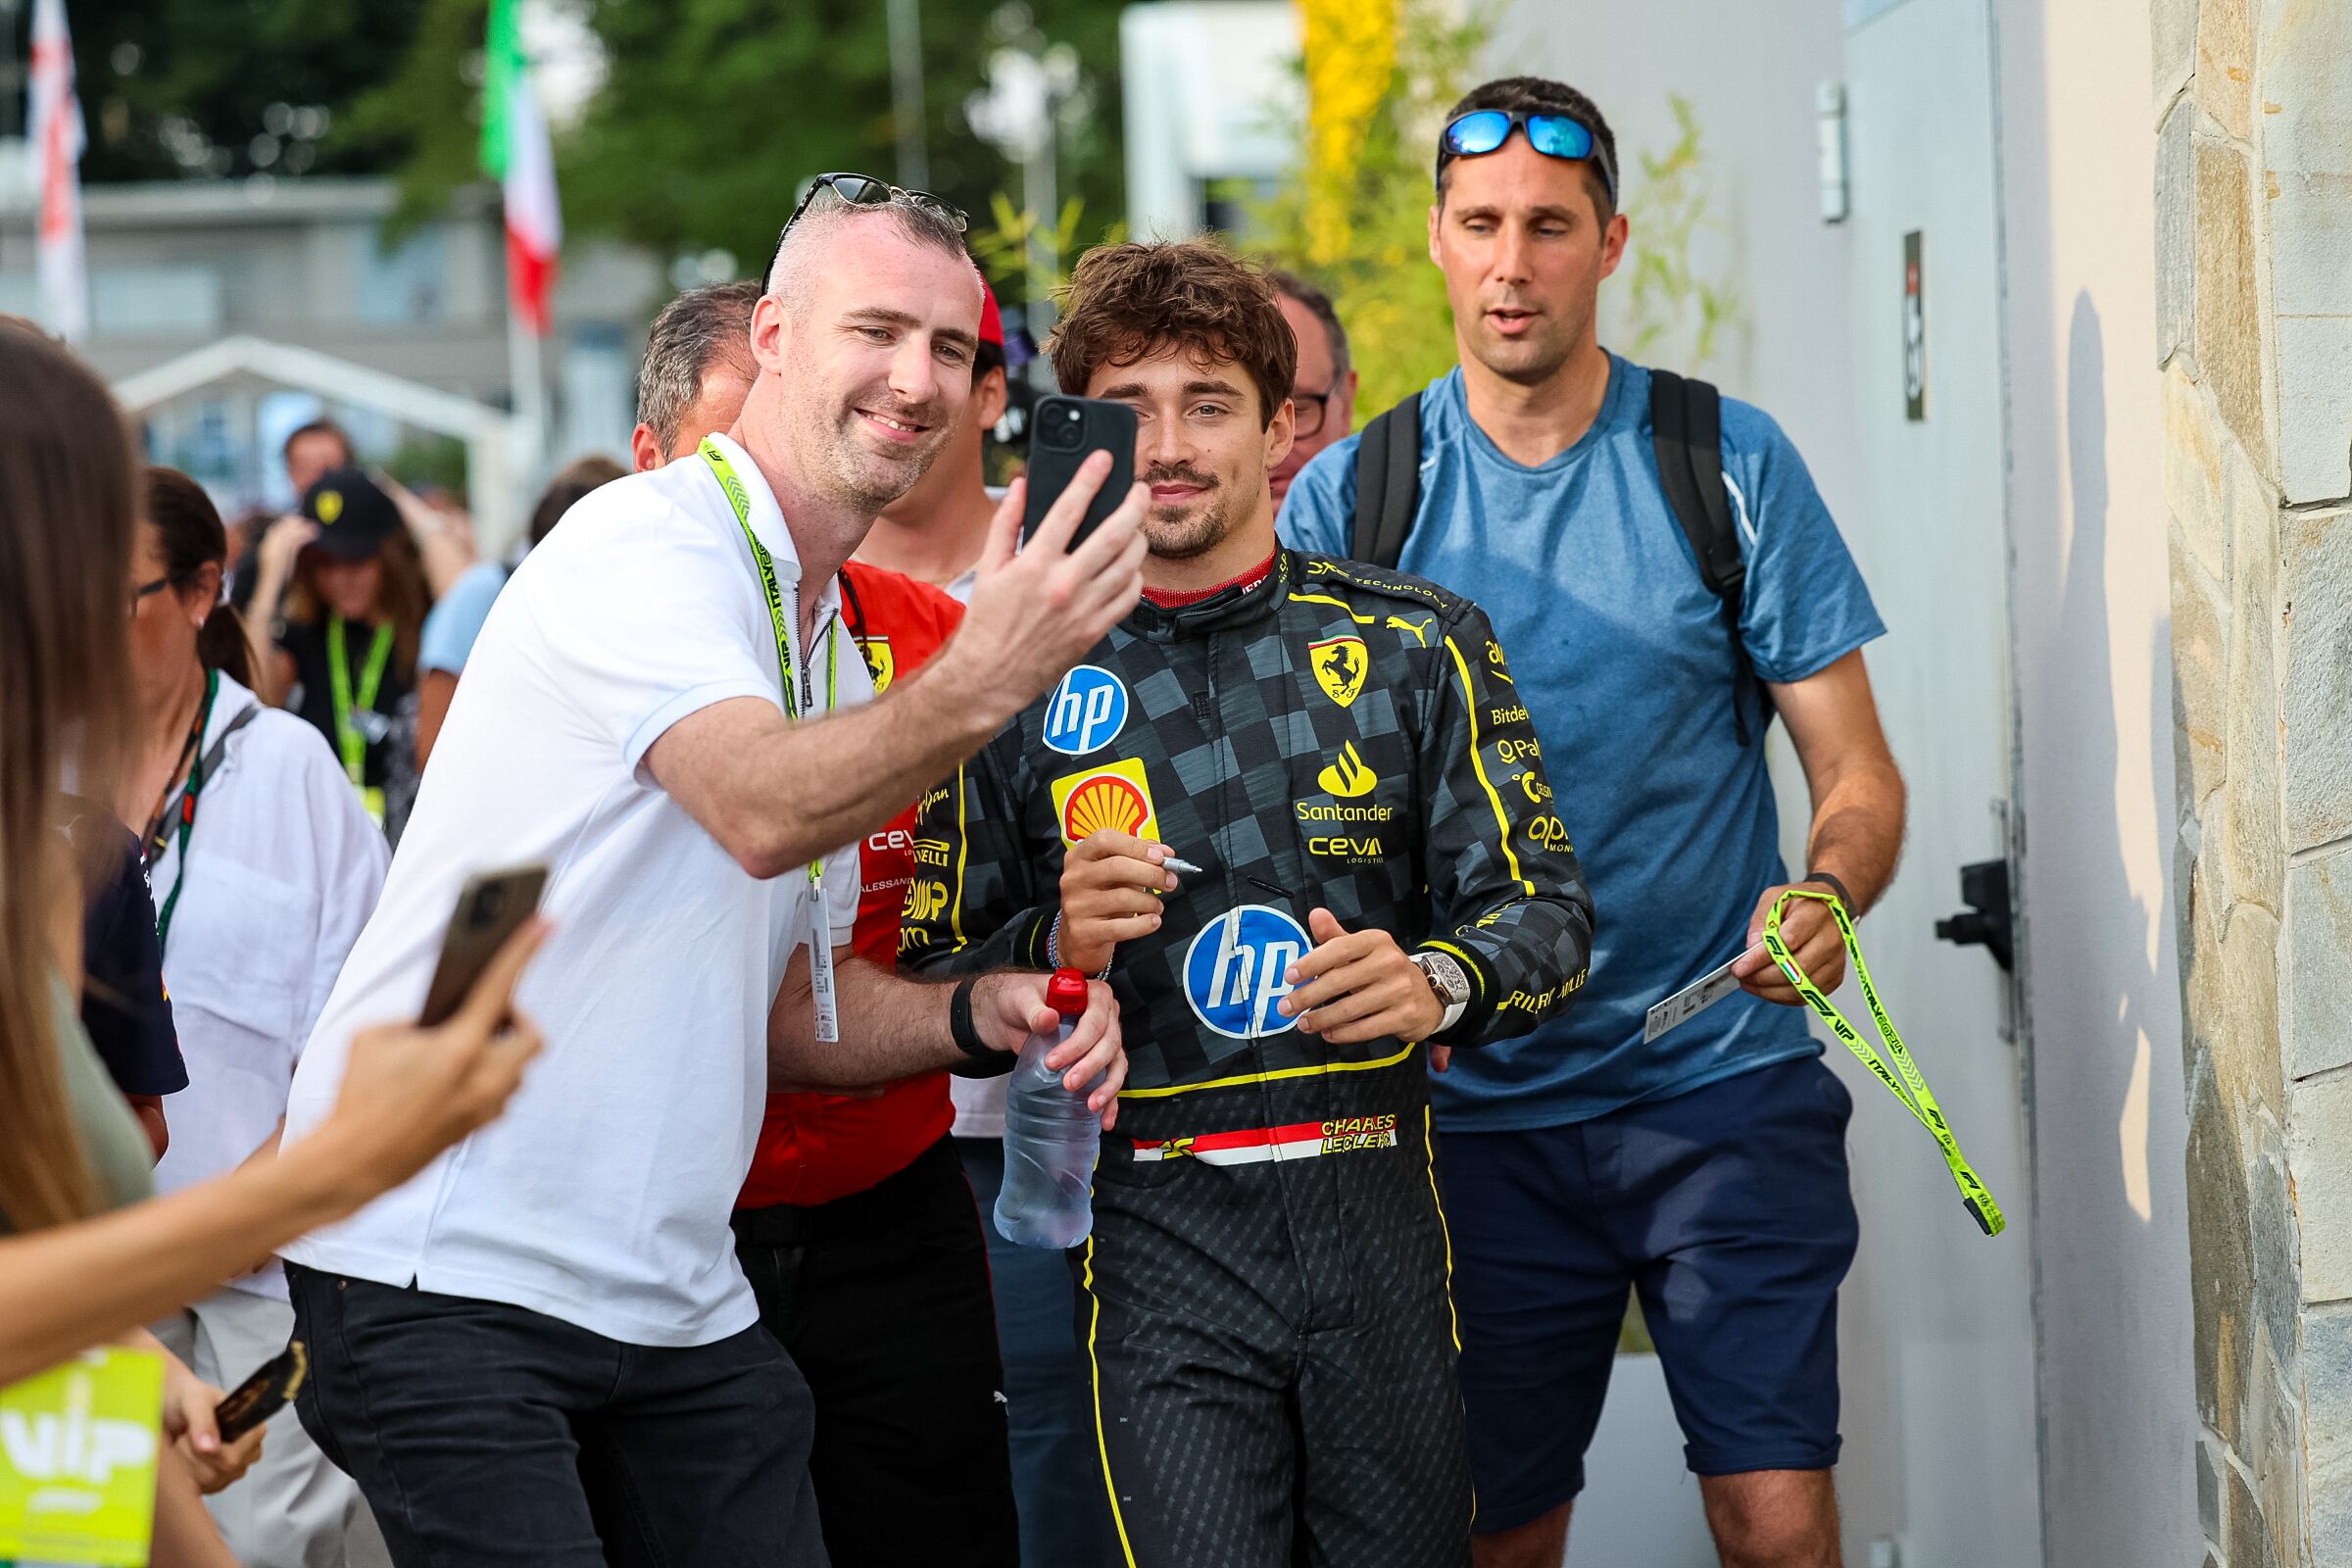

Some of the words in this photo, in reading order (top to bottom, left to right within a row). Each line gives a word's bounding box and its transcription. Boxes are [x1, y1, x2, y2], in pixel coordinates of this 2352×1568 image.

[1354, 577, 1448, 609] TECHNOLOGY
[1051, 669, 1115, 753] hp
[1296, 802, 1394, 821] Santander
[1204, 905, 1300, 1039] hp
[1800, 989, 1838, 1017] F1
[1834, 1018, 1855, 1041] VIP
